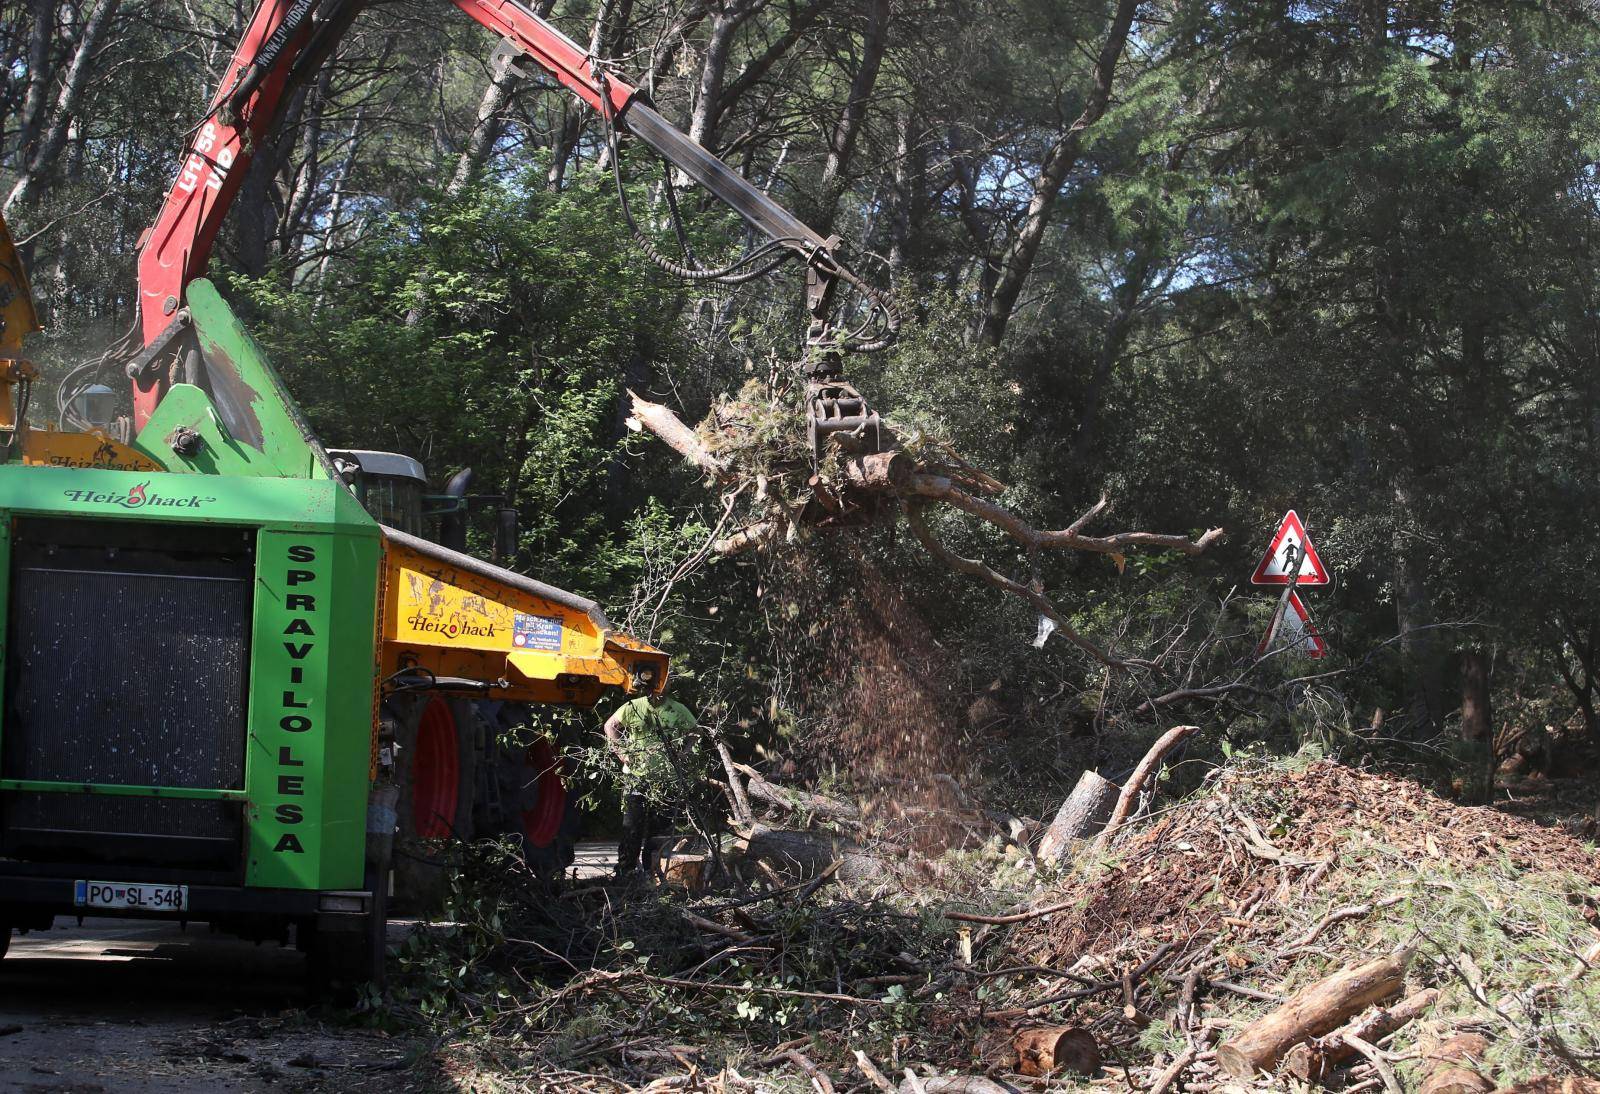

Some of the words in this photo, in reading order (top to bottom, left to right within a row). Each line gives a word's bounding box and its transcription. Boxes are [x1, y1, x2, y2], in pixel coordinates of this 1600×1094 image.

[278, 545, 315, 733] SPRAVILO
[272, 746, 305, 853] LESA
[90, 885, 114, 904] PO
[126, 887, 183, 907] SL-548
